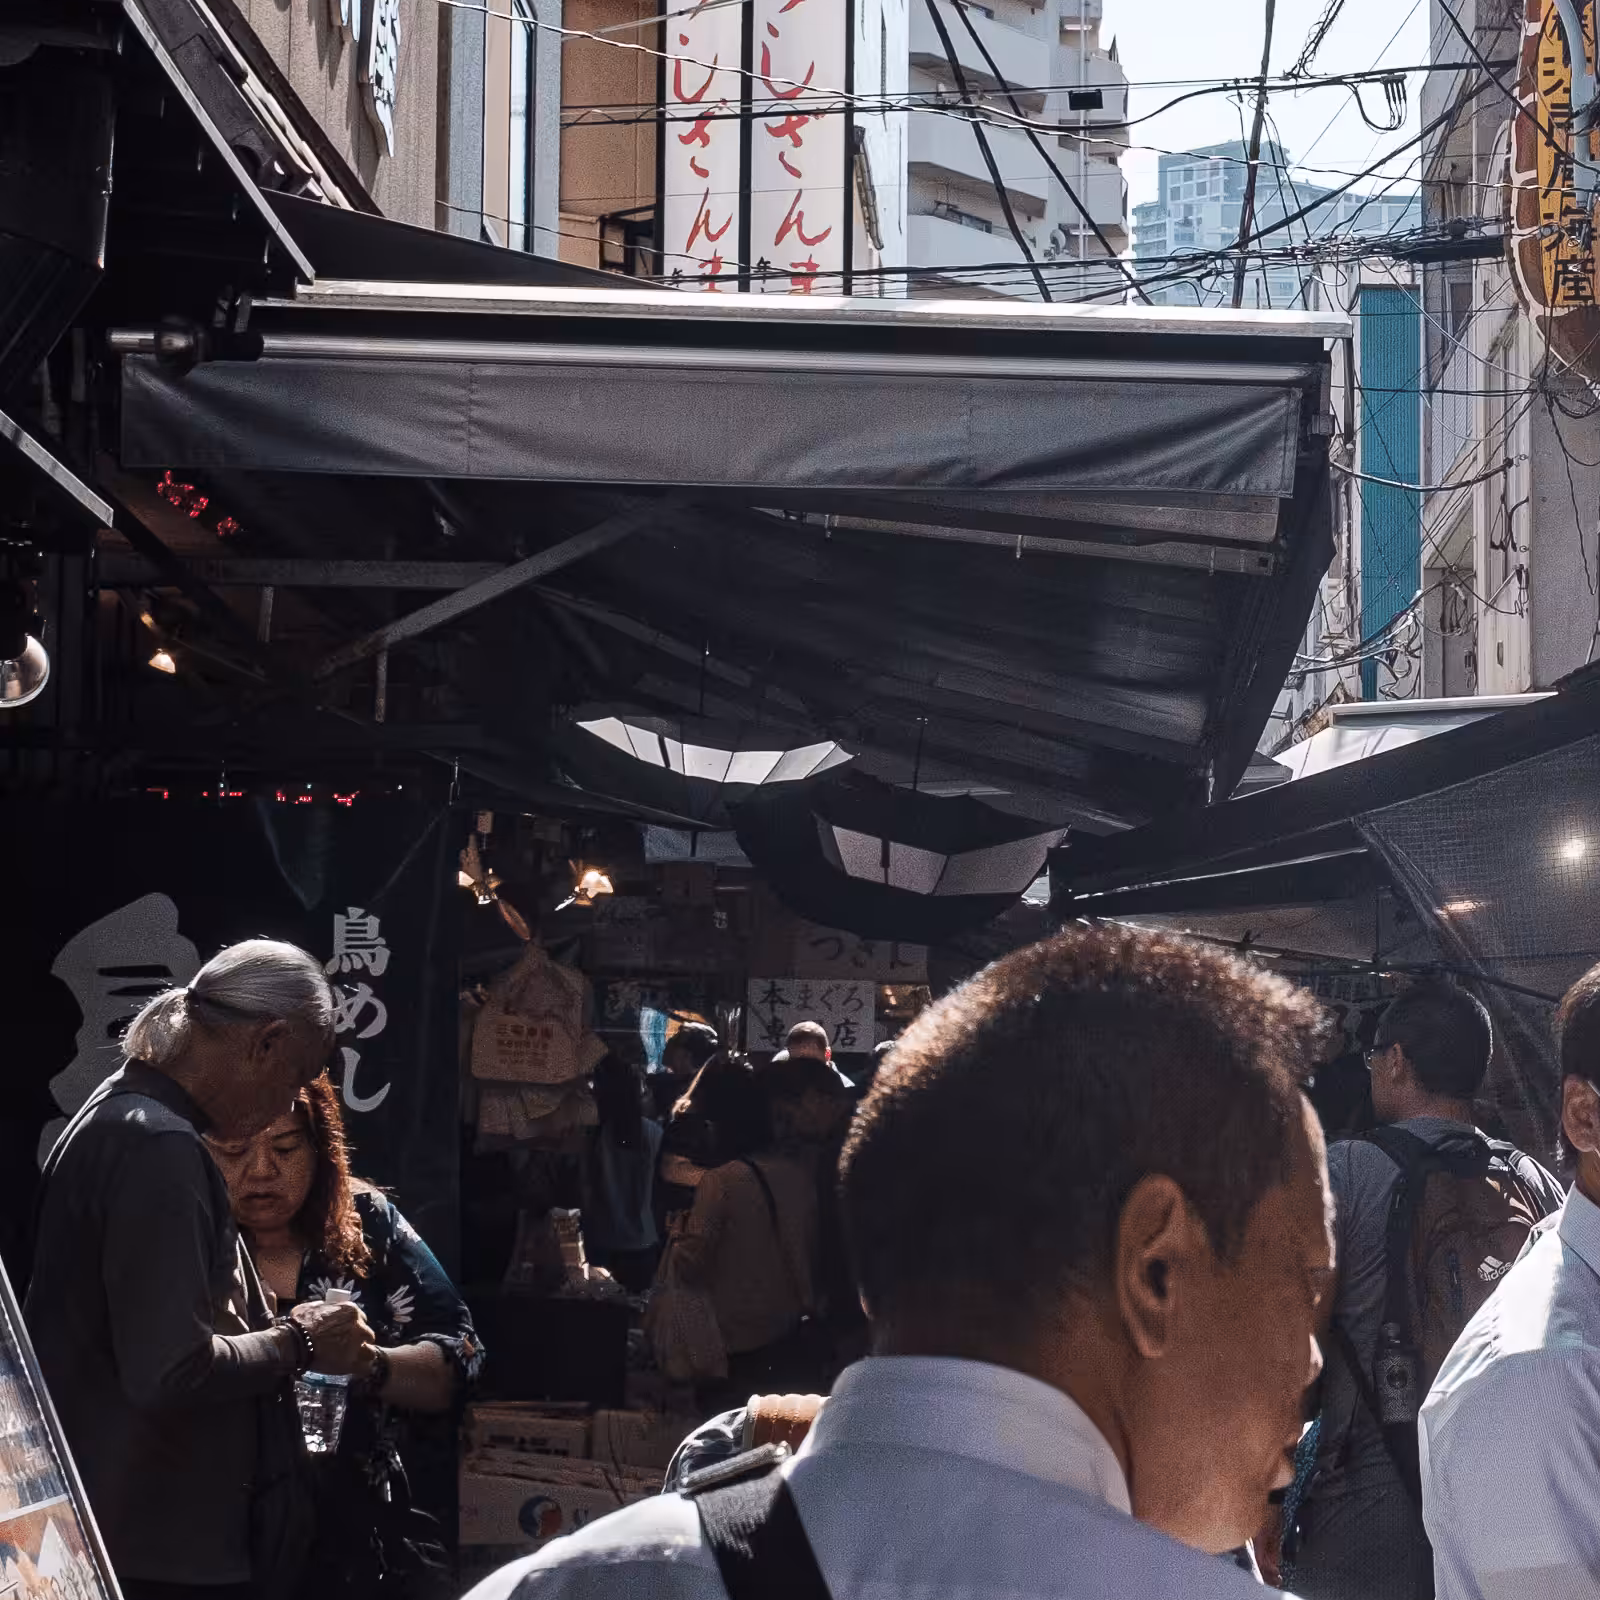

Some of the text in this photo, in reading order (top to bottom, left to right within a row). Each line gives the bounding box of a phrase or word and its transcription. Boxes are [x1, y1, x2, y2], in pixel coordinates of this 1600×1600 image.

[330, 907, 392, 1113] 鳥めし
[759, 1017, 859, 1049] 専店
